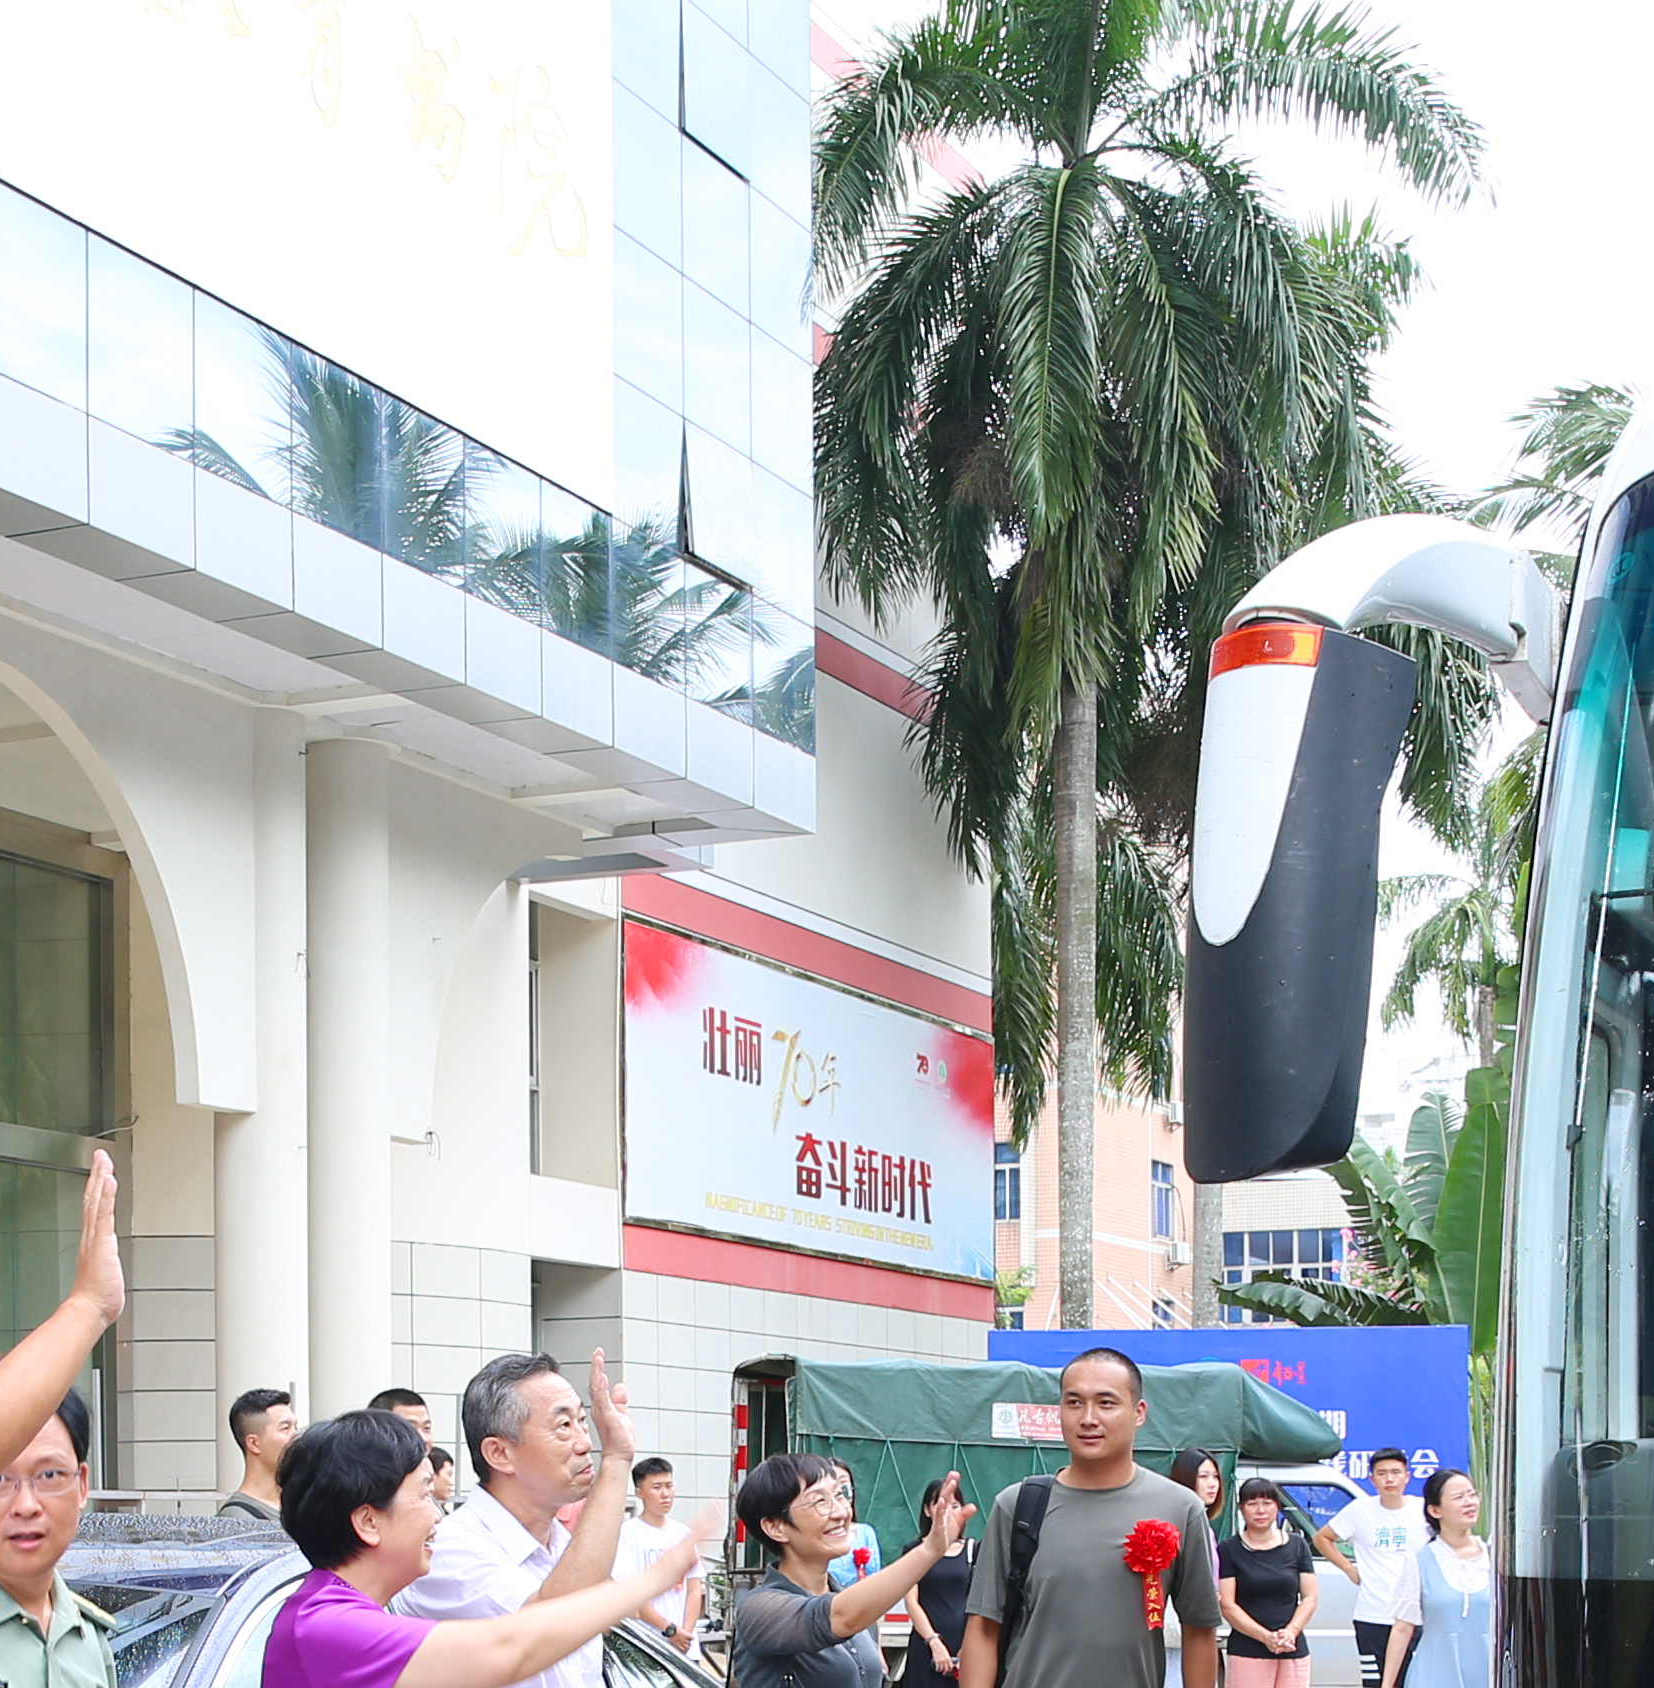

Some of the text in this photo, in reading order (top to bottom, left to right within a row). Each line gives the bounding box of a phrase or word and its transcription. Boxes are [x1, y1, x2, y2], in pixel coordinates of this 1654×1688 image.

[702, 1006, 842, 1135] 壮丽 70年
[795, 1132, 932, 1224] 奋斗新时代
